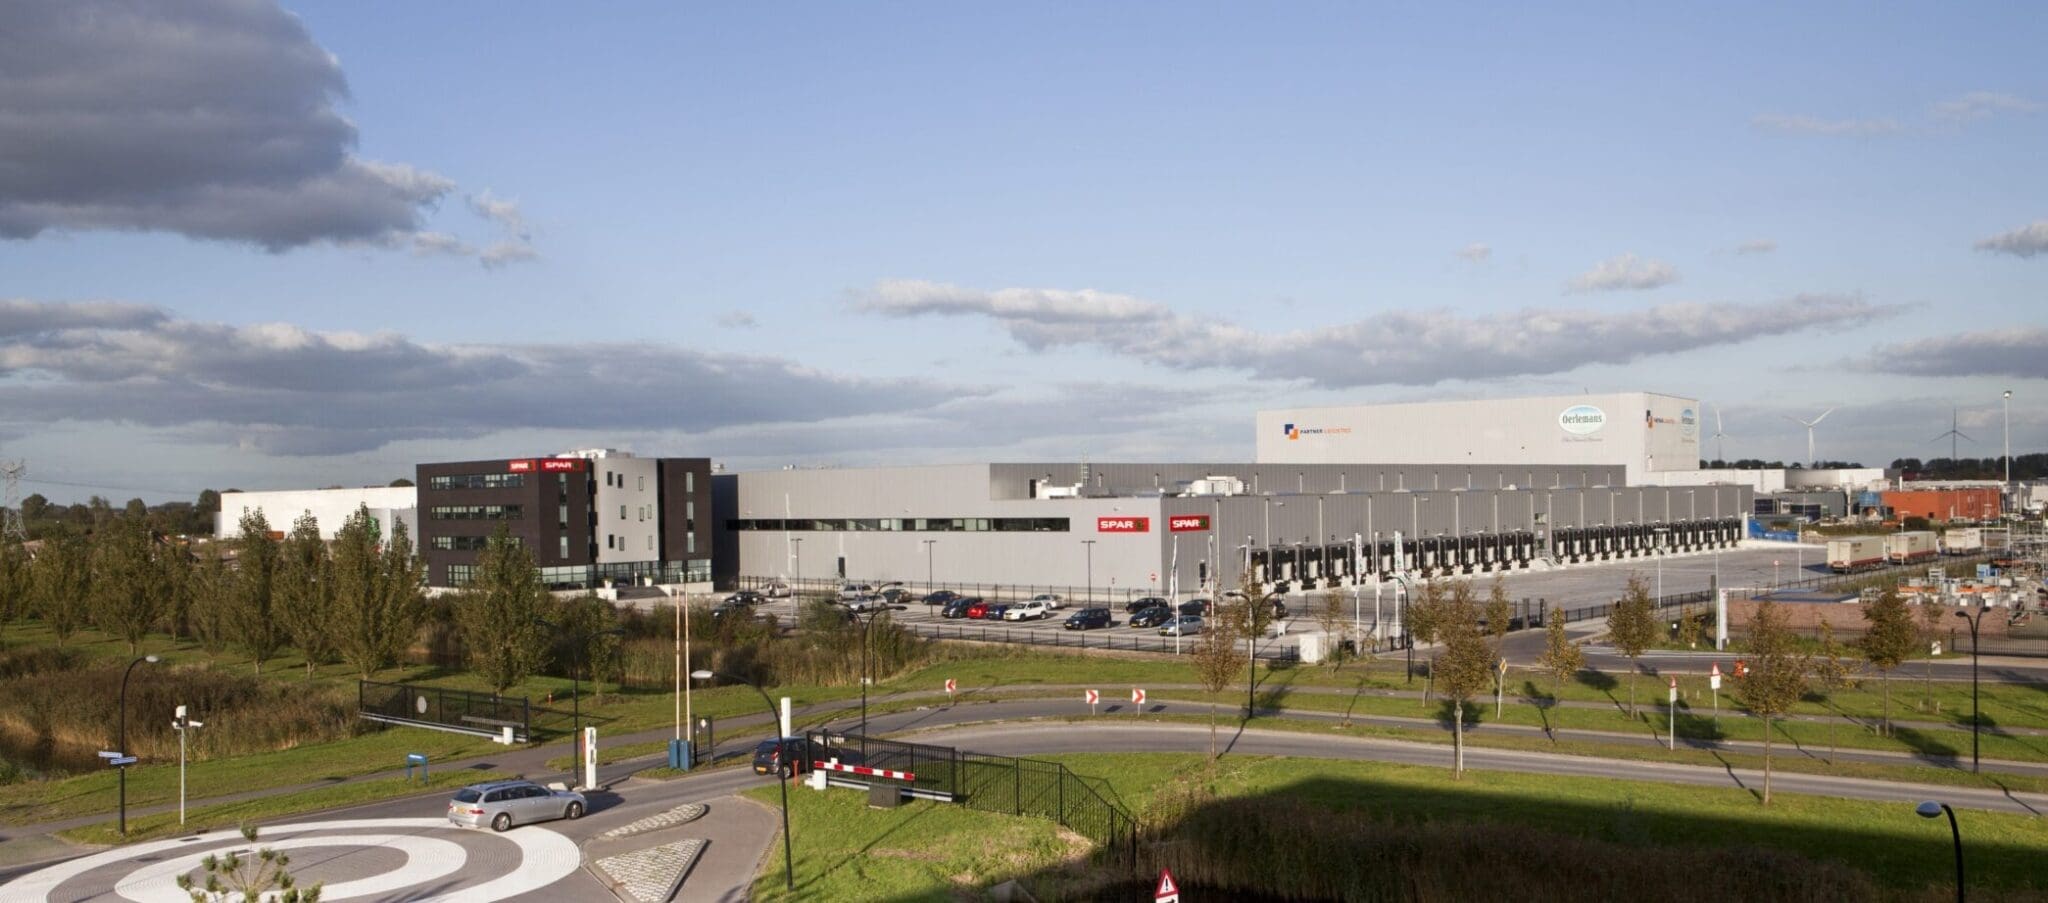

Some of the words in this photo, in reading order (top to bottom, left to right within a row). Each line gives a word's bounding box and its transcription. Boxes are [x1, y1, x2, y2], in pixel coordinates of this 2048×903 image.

[1562, 414, 1603, 424] Oerlemans
[1100, 520, 1134, 529] SPAR
[1172, 519, 1201, 528] SPAR
